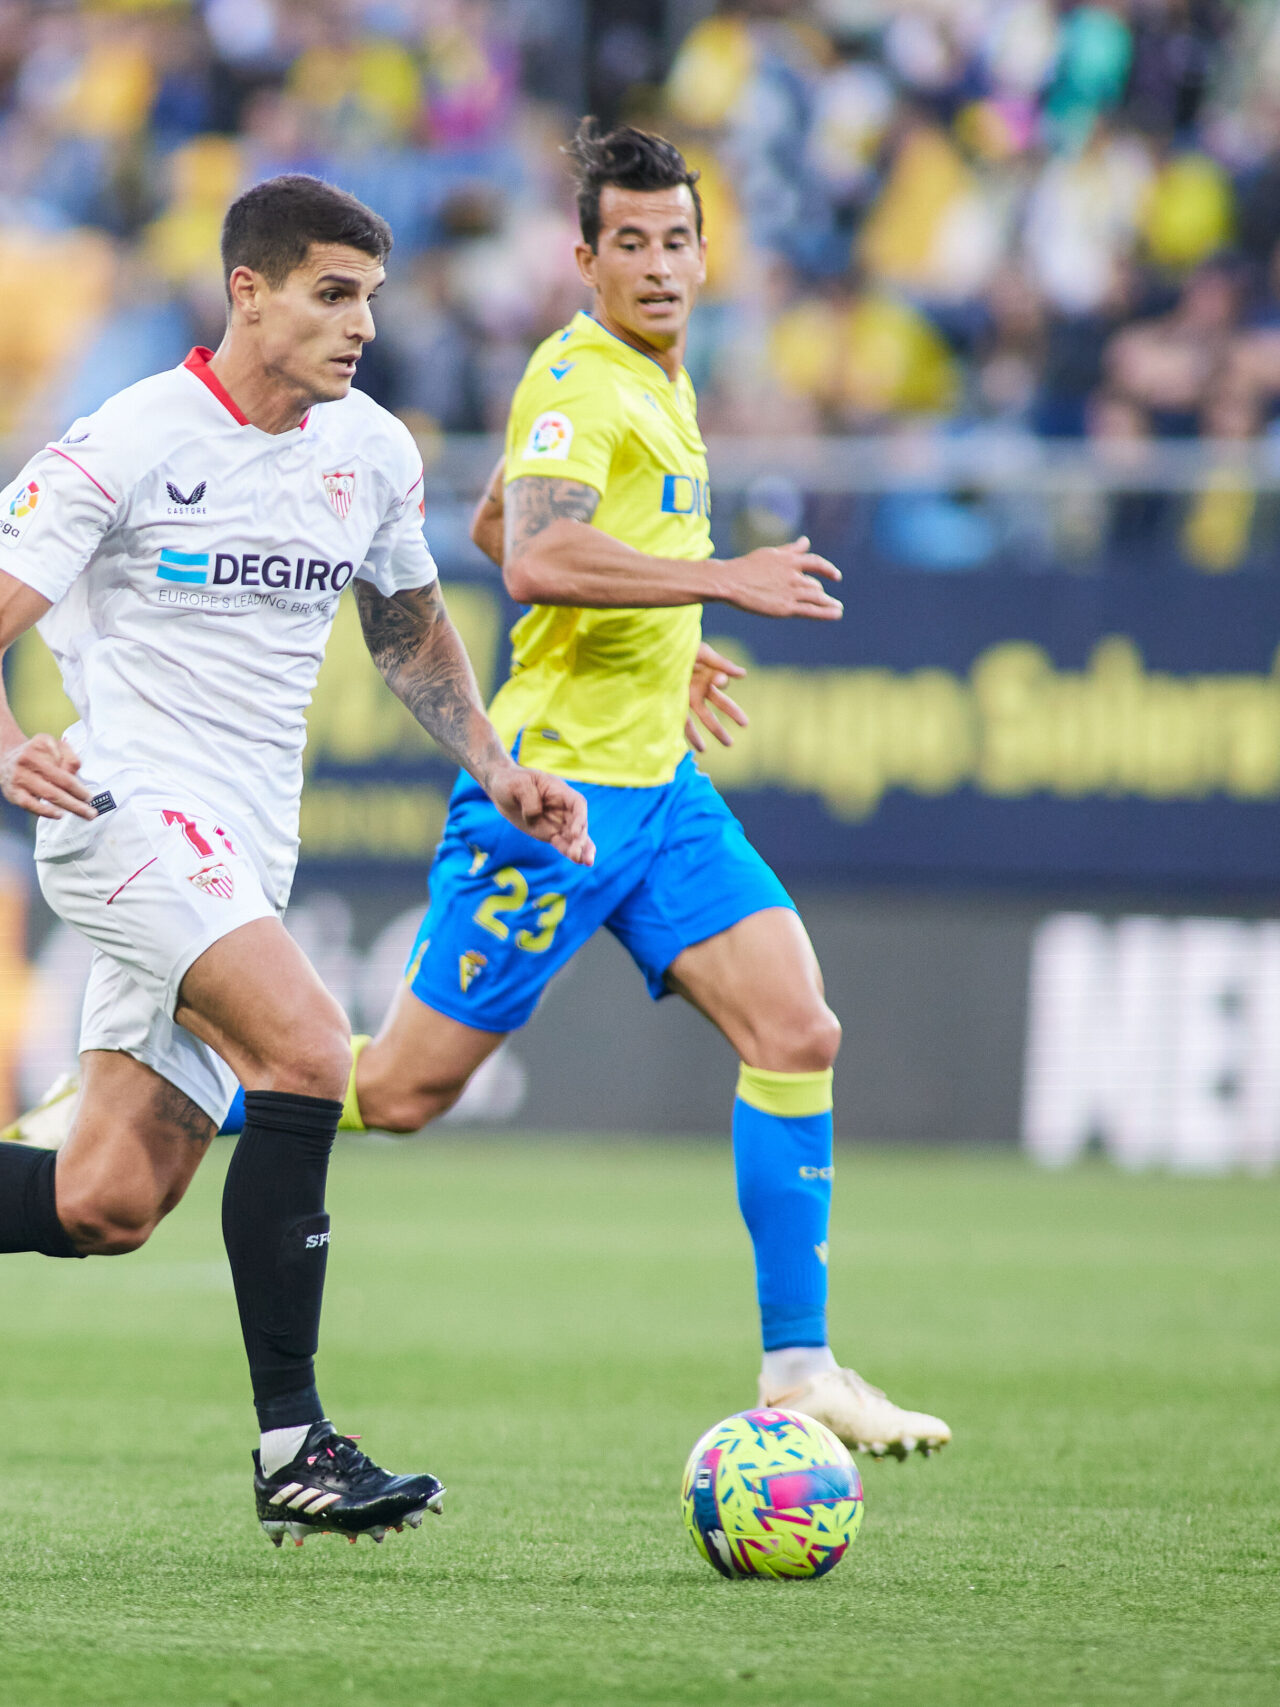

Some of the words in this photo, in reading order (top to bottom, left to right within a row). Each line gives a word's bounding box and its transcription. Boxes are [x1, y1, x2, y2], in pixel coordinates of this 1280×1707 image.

[167, 506, 207, 515] CASTORE
[213, 552, 354, 592] DEGIRO
[234, 593, 288, 610] LEADING
[473, 866, 568, 954] 23
